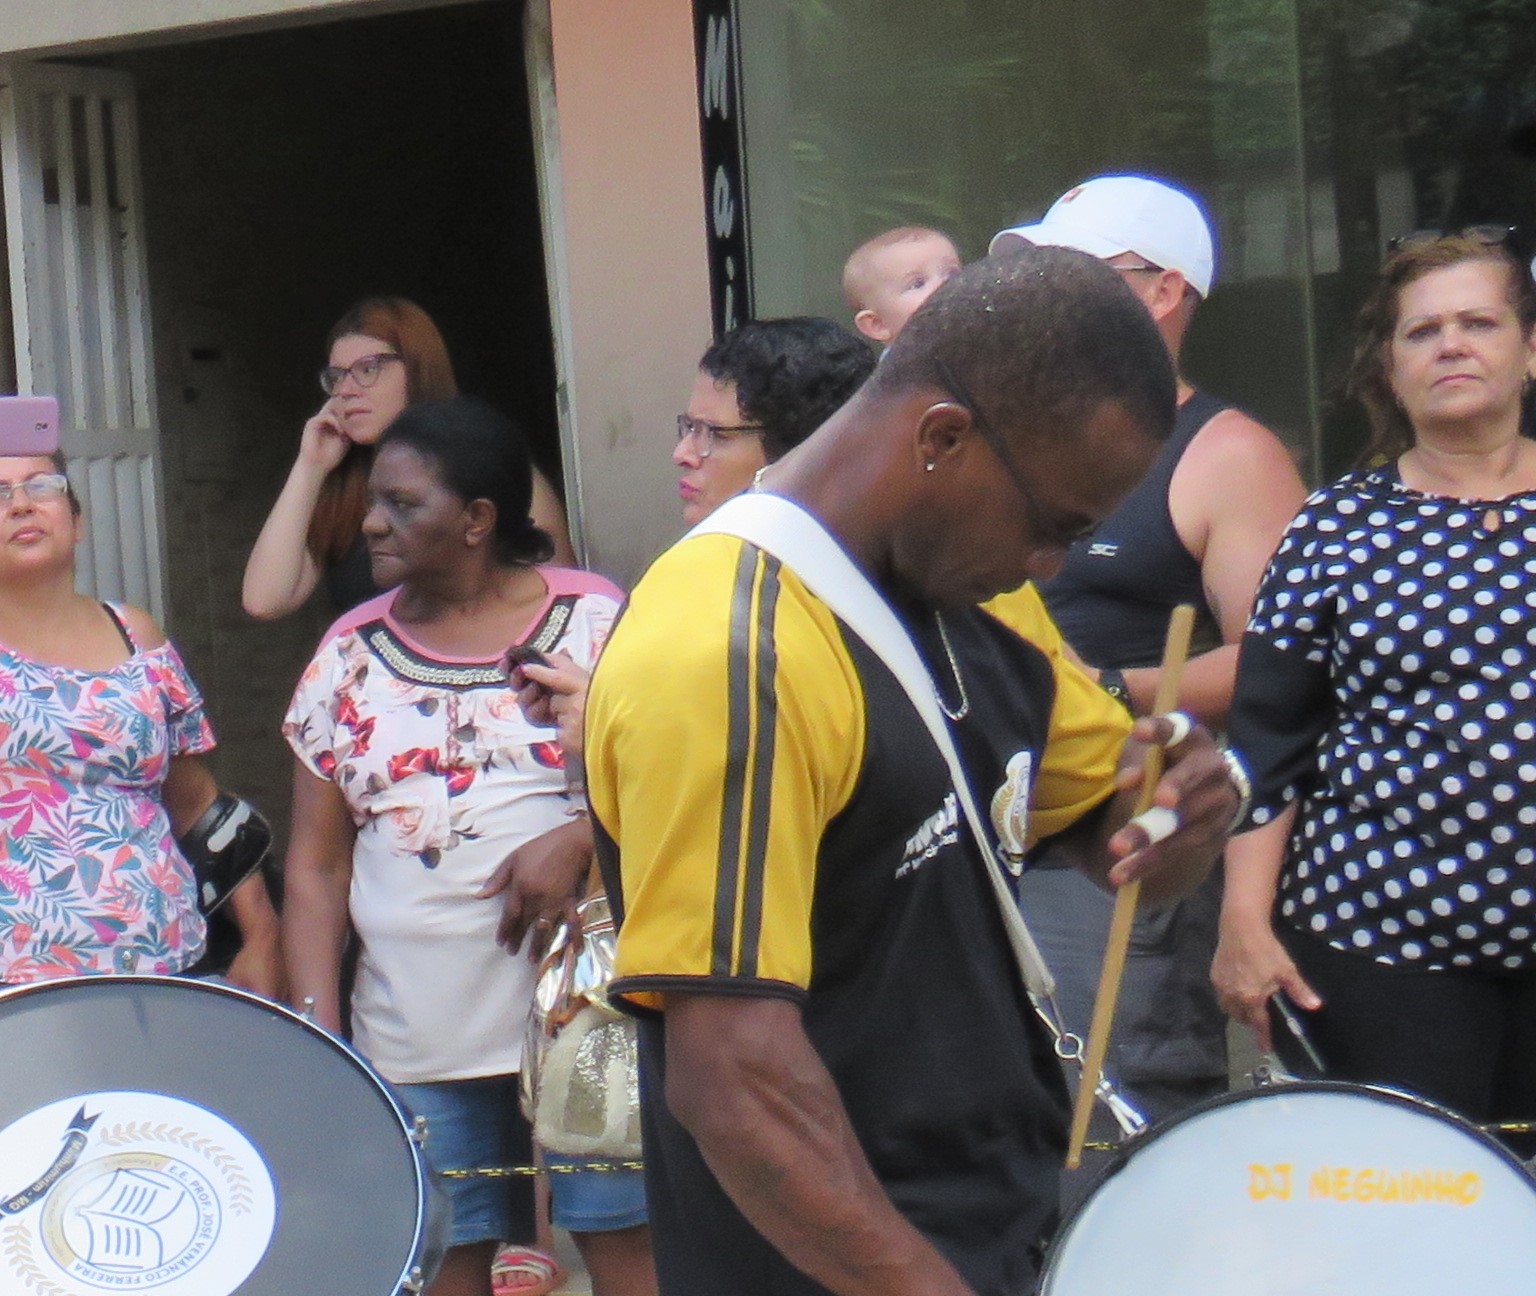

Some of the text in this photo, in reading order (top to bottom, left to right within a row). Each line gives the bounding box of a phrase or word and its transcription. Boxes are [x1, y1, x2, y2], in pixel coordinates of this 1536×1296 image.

[1247, 1162, 1484, 1207] DJ NEGUINHO
[74, 1262, 142, 1285] FERREIRA
